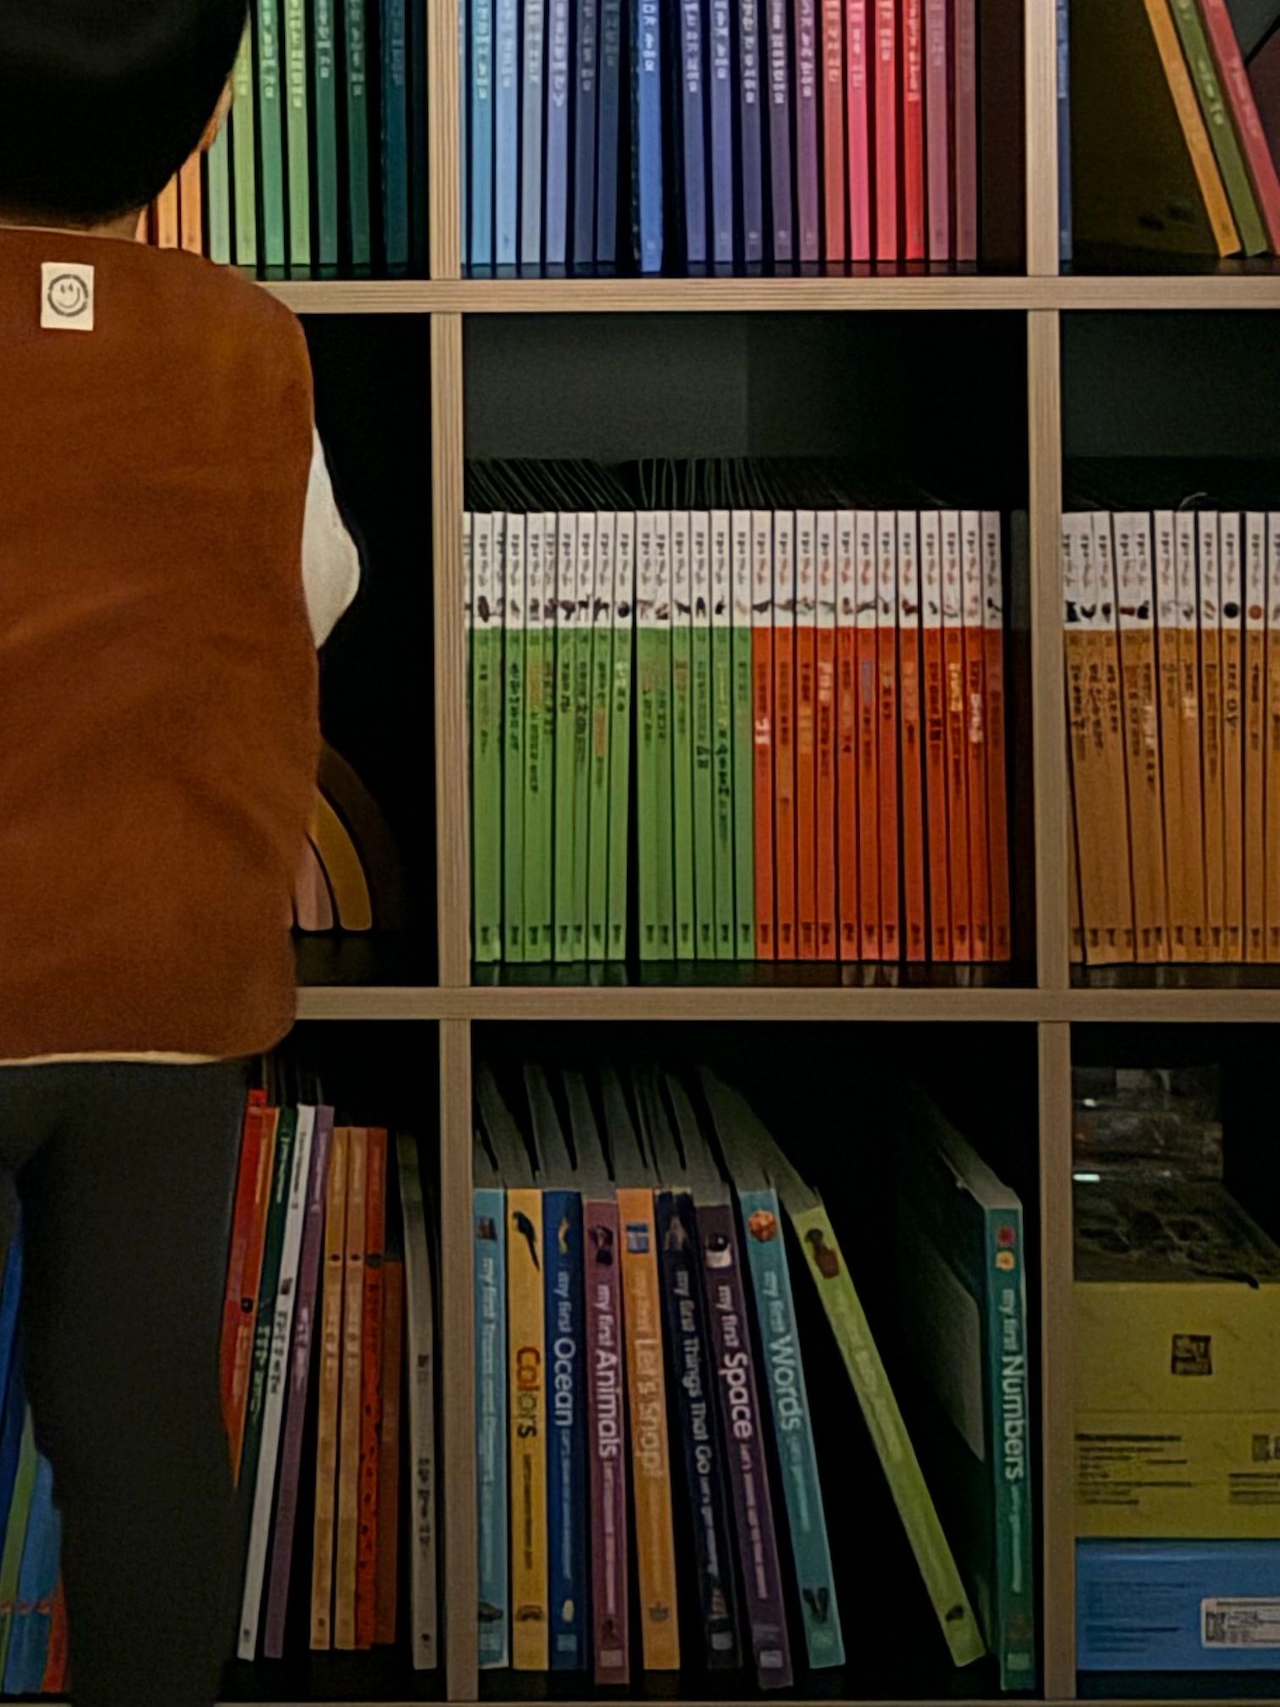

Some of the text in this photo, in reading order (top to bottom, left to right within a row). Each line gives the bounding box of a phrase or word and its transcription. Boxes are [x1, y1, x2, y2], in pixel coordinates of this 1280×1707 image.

[553, 1271, 570, 1298] my
[593, 1284, 611, 1310] my
[673, 1270, 691, 1297] my
[716, 1285, 734, 1312] my
[762, 1271, 780, 1298] my
[557, 1301, 573, 1332] first
[678, 1299, 697, 1332] first
[768, 1300, 787, 1333] first
[999, 1288, 1017, 1314] my
[597, 1314, 615, 1347] first
[721, 1315, 741, 1348] first
[1002, 1318, 1019, 1351] first
[553, 1337, 577, 1426] Ocean
[634, 1339, 660, 1395] Let's
[681, 1337, 704, 1398] Things
[768, 1335, 803, 1431] Words
[517, 1346, 541, 1439] Colors
[595, 1348, 620, 1458] Animals
[719, 1351, 754, 1439] Space
[689, 1402, 708, 1441] That
[1001, 1354, 1025, 1481] Numbers
[694, 1445, 712, 1475] Go
